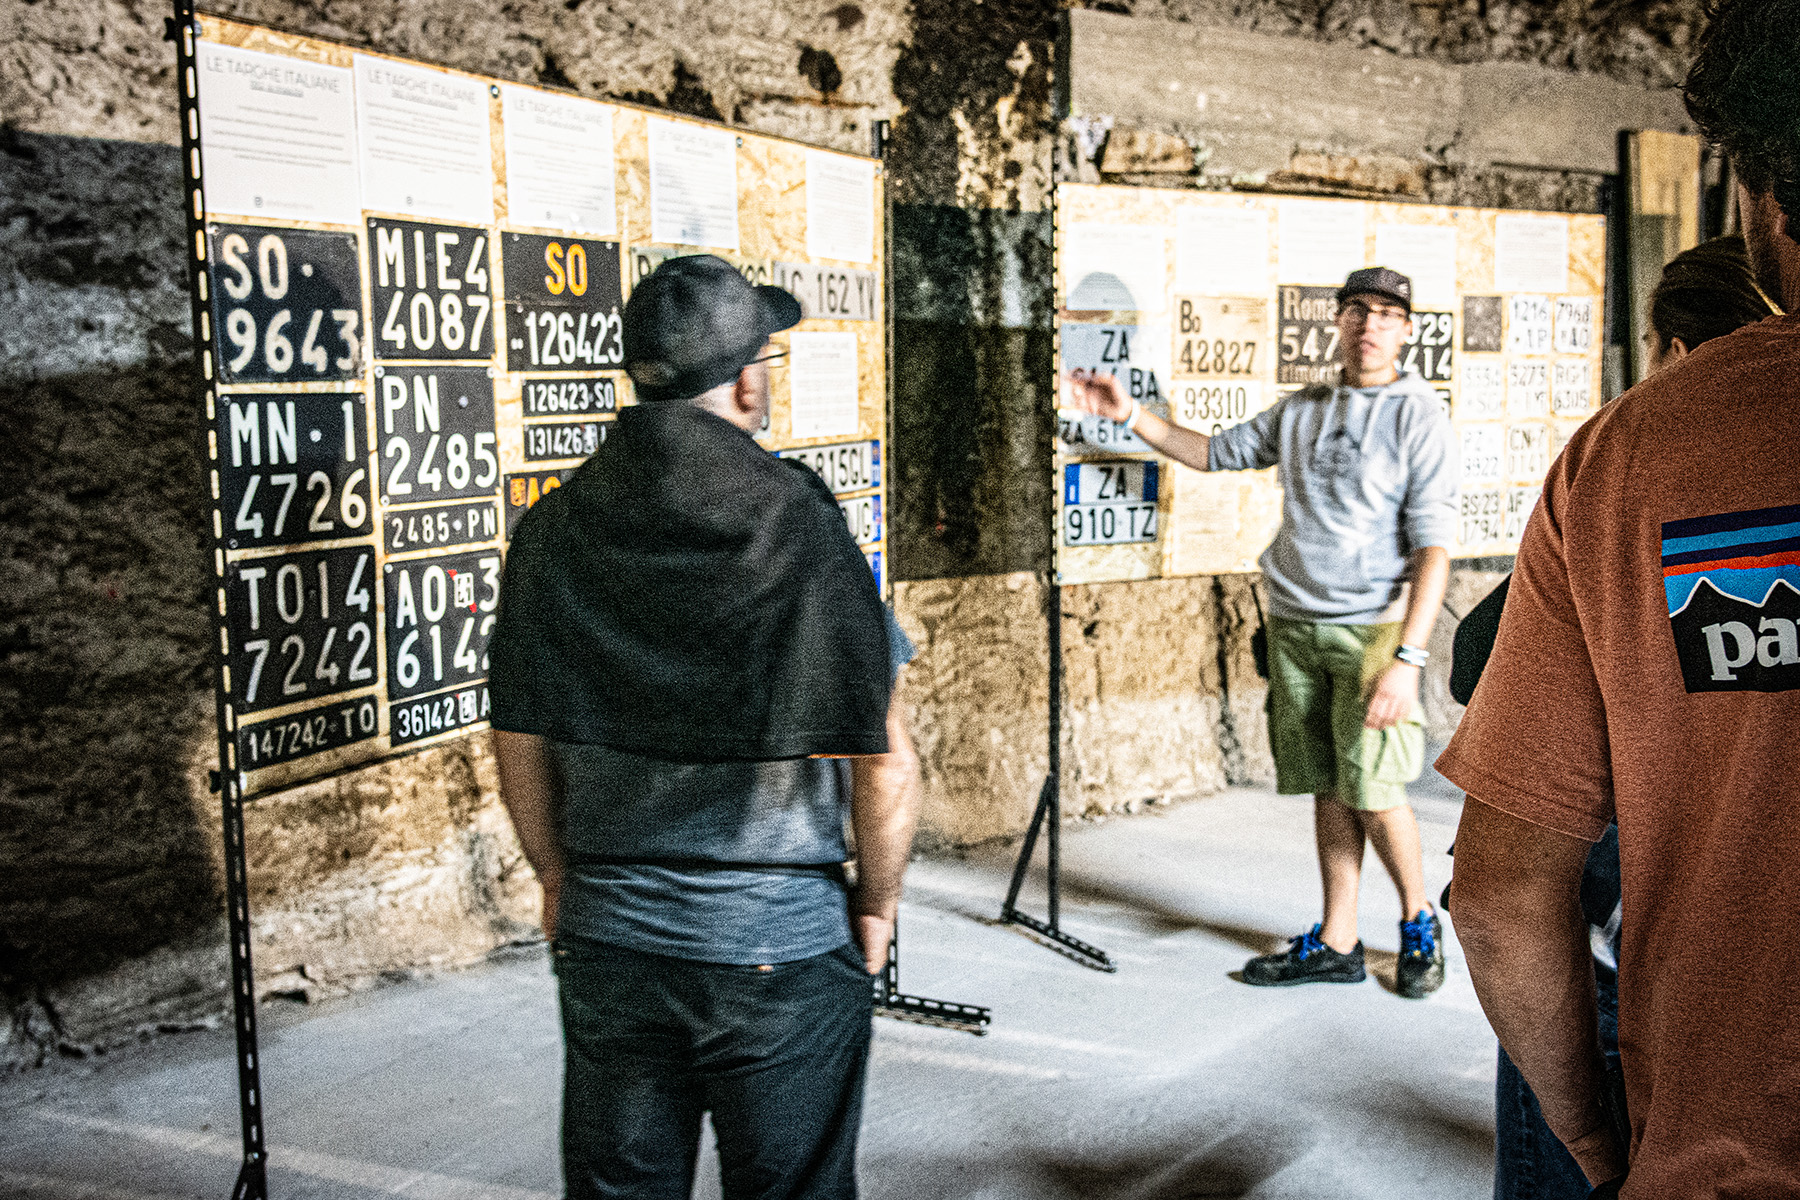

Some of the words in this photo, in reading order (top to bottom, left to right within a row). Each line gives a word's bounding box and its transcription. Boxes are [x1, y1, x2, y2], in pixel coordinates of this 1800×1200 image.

[222, 233, 289, 300] SO
[545, 242, 588, 296] SO
[817, 272, 850, 313] 162
[382, 291, 490, 351] 4087
[1282, 287, 1339, 321] Roma
[226, 308, 359, 373] 9643
[1101, 330, 1130, 362] ZA
[1180, 340, 1256, 373] 42827
[1281, 326, 1340, 362] 547
[383, 375, 440, 434] PN
[528, 382, 589, 412] 126423
[594, 382, 615, 409] SO
[1130, 369, 1160, 399] BA
[1184, 387, 1247, 419] 93310
[229, 401, 297, 468] MN
[341, 400, 355, 462] 1
[385, 432, 498, 496] 2485
[1098, 467, 1127, 499] ZA
[235, 468, 367, 538] 4726
[391, 512, 449, 548] 2485
[467, 507, 495, 538] PN
[1070, 508, 1115, 540] 910
[1127, 506, 1155, 537] TZ
[396, 565, 447, 628] AO
[478, 557, 500, 612] 3
[244, 622, 372, 703] 7242
[1701, 616, 1800, 682] pa
[249, 716, 327, 762] 147242
[341, 703, 375, 737] TO
